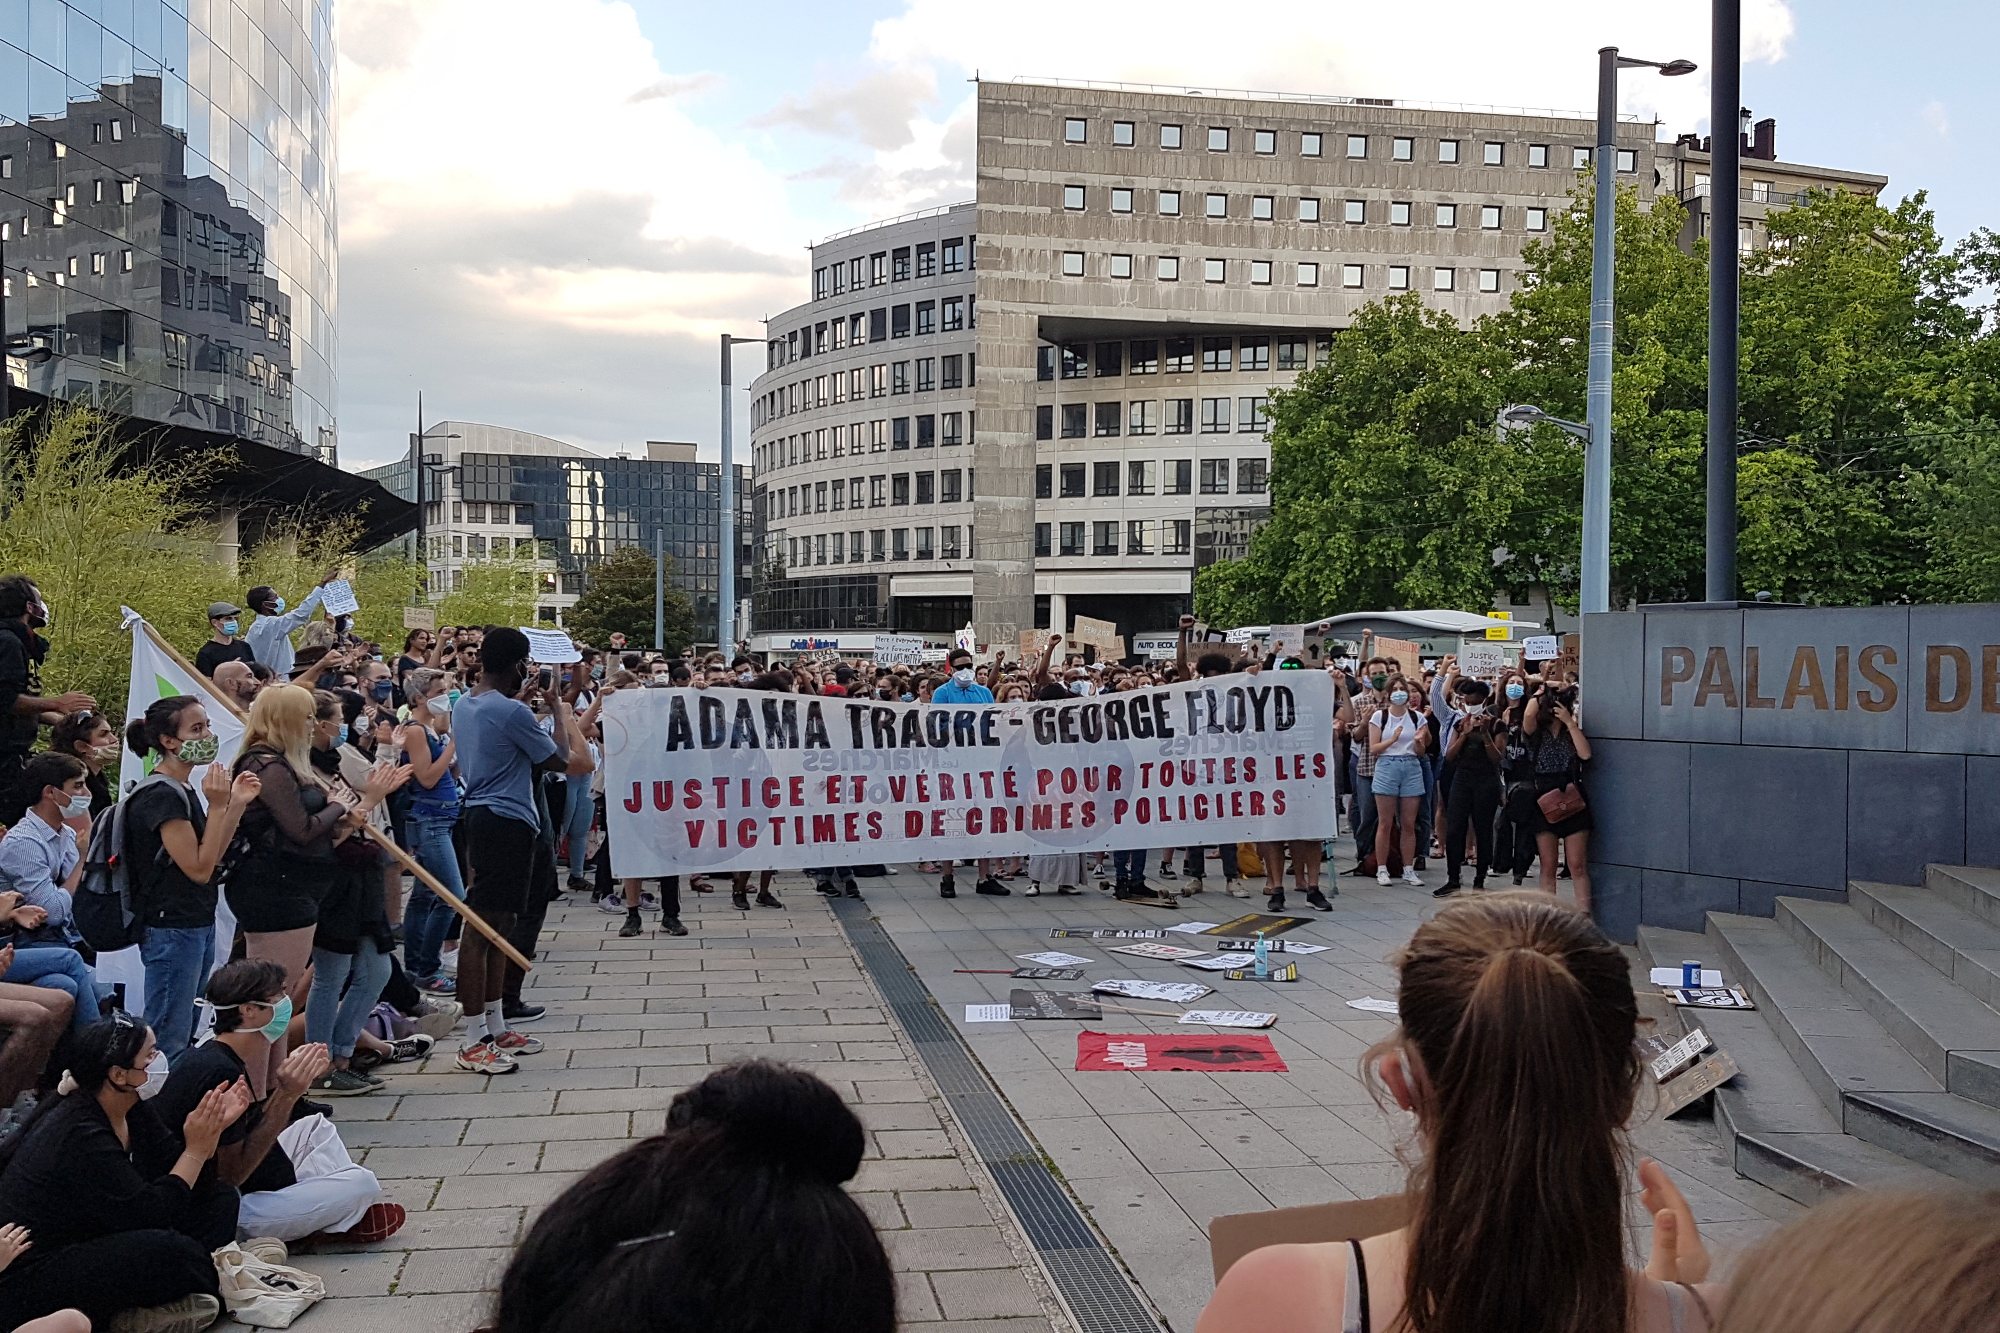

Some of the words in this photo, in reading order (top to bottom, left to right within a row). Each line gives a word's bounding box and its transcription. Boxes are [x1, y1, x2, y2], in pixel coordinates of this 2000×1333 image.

[874, 653, 889, 663] BLACK
[904, 653, 923, 665] MATTER
[1468, 652, 1499, 661] JUSTICE
[1565, 647, 1576, 655] DE
[1466, 665, 1497, 674] ADAMA
[1661, 645, 1898, 712] PALAIS
[666, 695, 831, 752] ADAMA
[1033, 691, 1175, 746] GEORGE
[1185, 685, 1296, 736] FLOYD
[624, 775, 805, 813] JUSTICE
[827, 774, 868, 804] ET
[888, 766, 1018, 803] VÉRITÉ
[1037, 764, 1122, 796] POUR
[1140, 756, 1257, 790] TOUTES
[1275, 752, 1327, 781] LES
[685, 810, 883, 849] VICTIMES
[904, 809, 946, 839] DE
[965, 800, 1096, 835] CRIMES
[1113, 789, 1287, 825] POLICIERS
